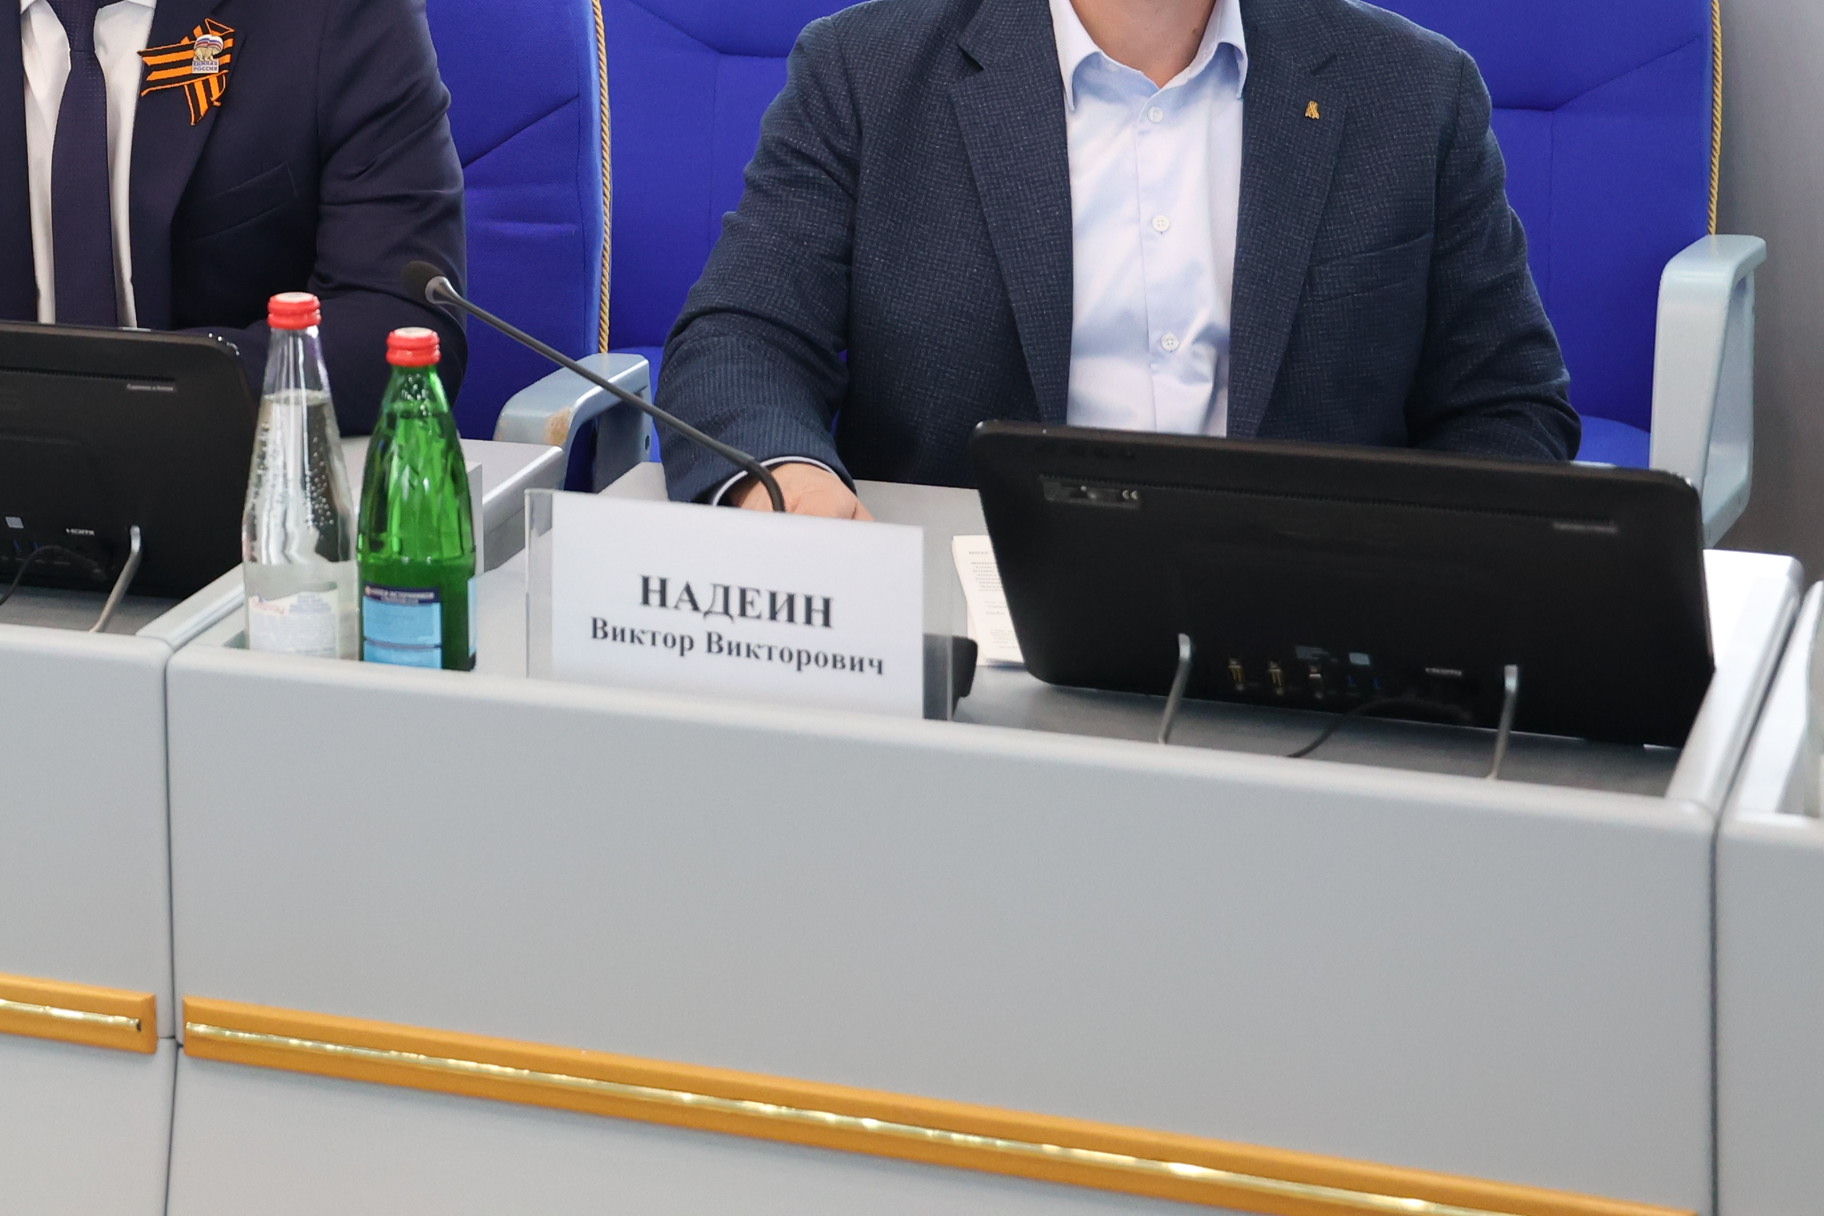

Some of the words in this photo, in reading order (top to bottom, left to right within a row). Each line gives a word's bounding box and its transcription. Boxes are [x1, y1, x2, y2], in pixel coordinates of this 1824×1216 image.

[640, 575, 833, 629] НАДЕИН
[591, 616, 695, 658] Виктор
[706, 631, 883, 676] Викторович
